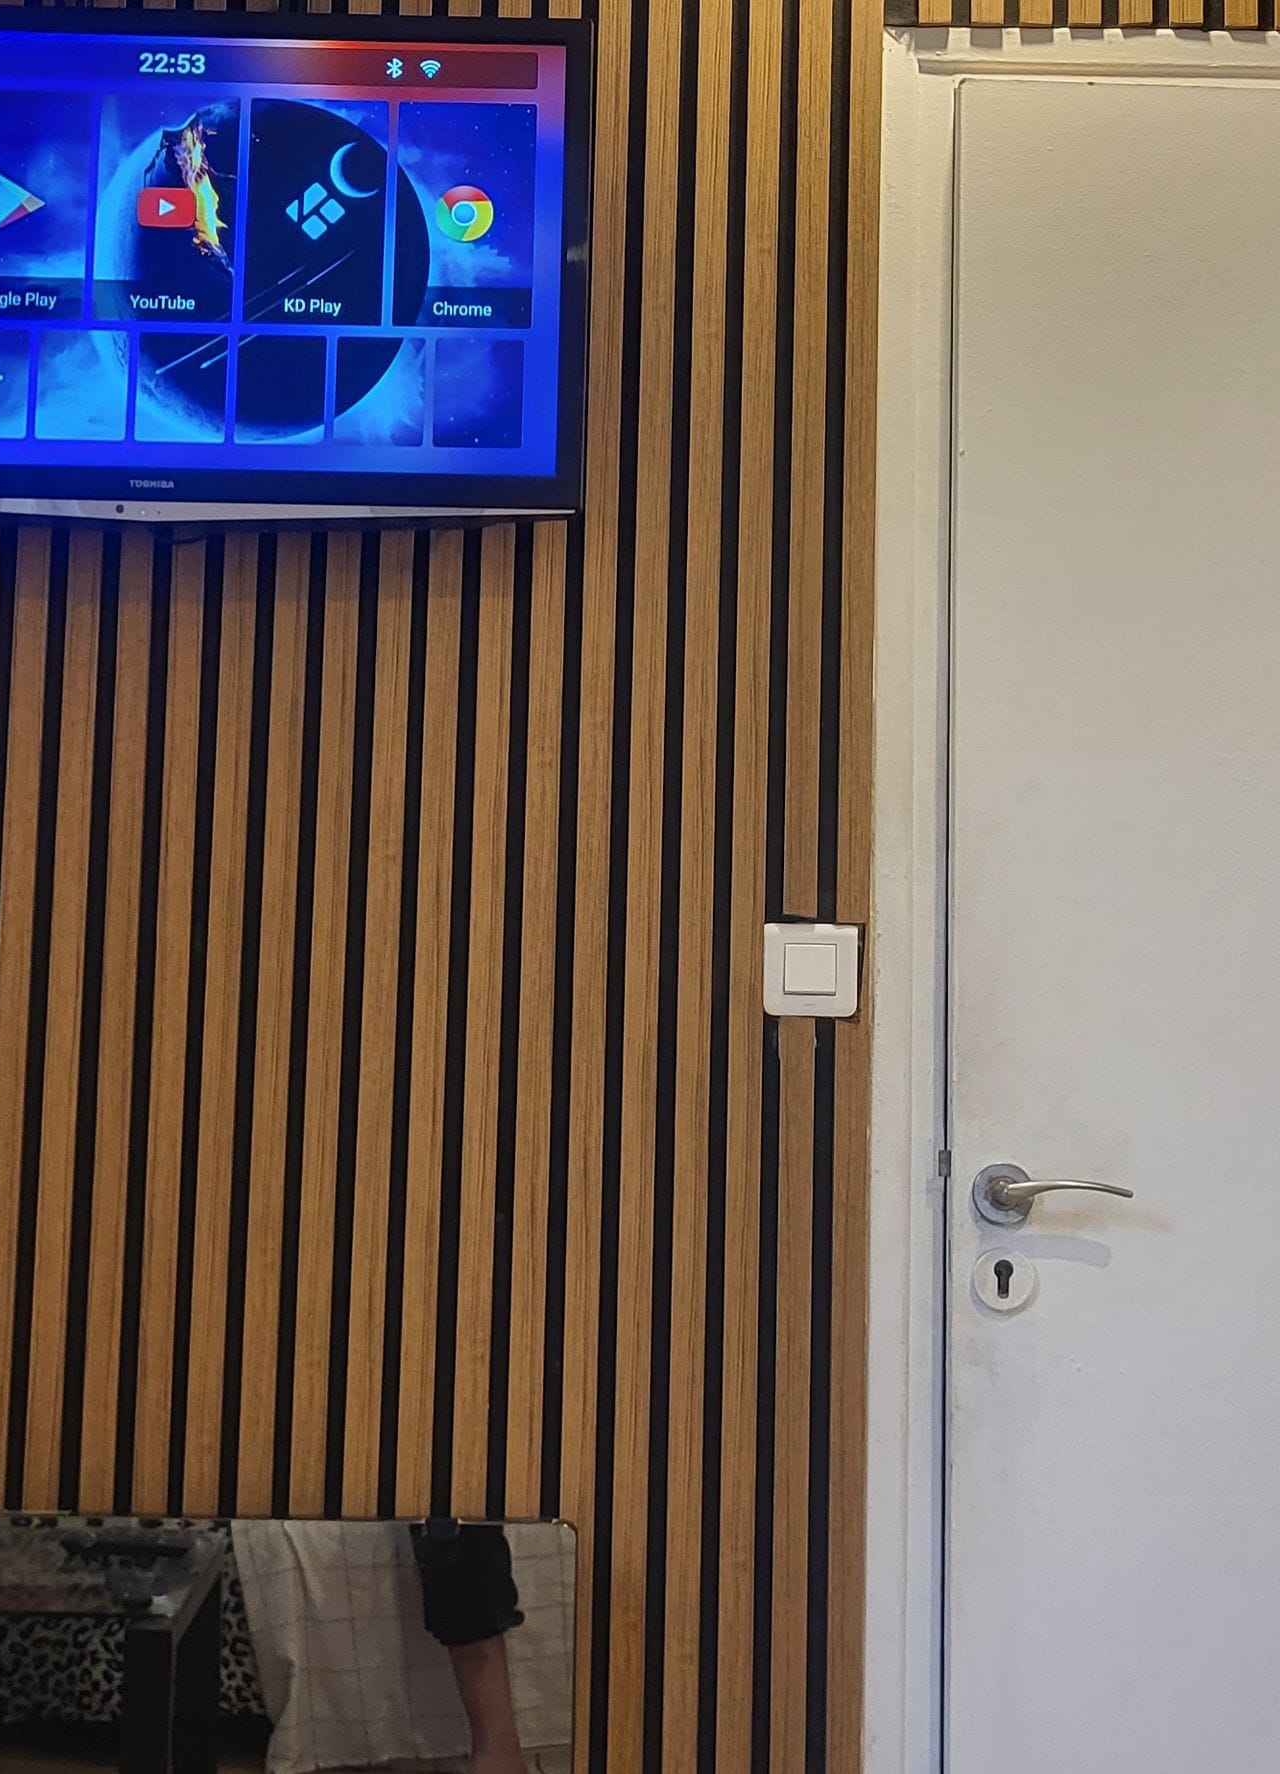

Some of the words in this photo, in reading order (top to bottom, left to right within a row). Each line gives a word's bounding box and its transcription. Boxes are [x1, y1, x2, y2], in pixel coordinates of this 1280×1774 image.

[138, 53, 206, 74] 22:53
[25, 291, 57, 310] Play
[129, 294, 196, 311] YouTube
[284, 298, 306, 313] KD
[309, 298, 342, 316] Play
[432, 301, 493, 317] Chrome
[129, 479, 175, 489] TOSHIBA
